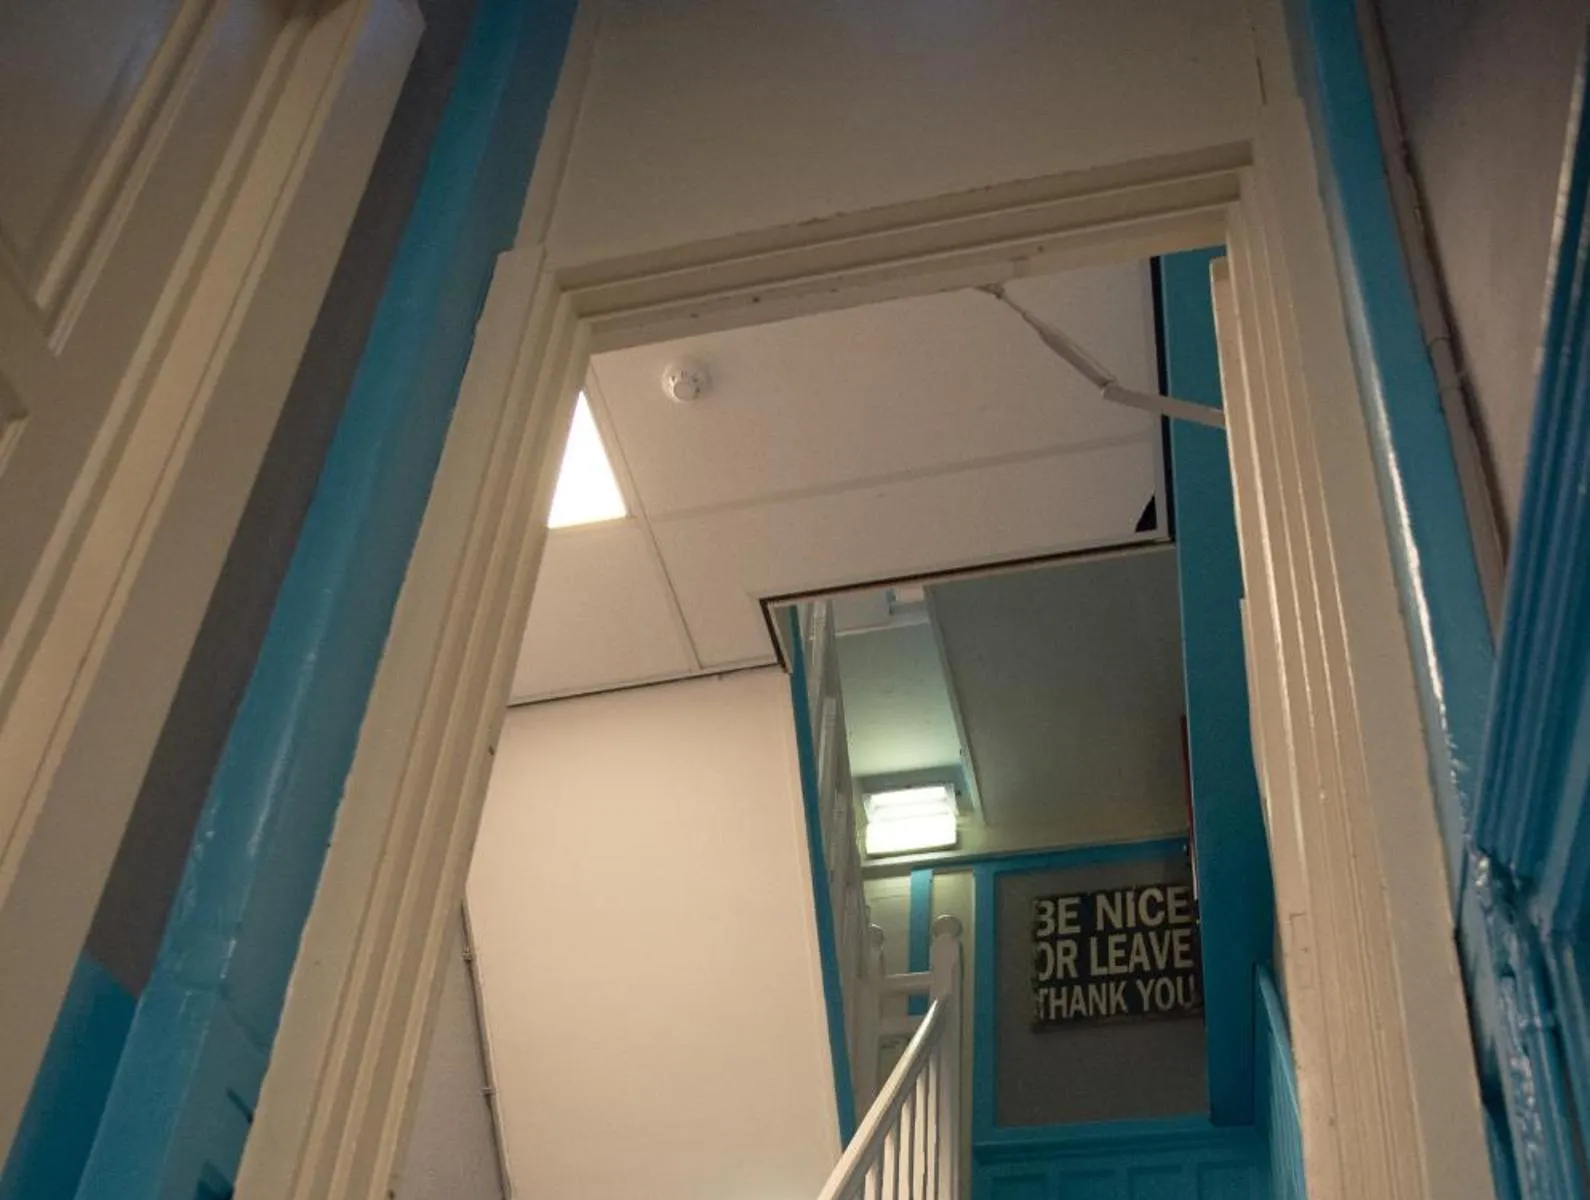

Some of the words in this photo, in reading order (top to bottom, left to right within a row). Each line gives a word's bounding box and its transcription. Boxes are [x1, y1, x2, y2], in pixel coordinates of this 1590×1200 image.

[1034, 898, 1081, 936] BE
[1096, 887, 1192, 930] NICE
[1037, 940, 1078, 980] OR
[1090, 929, 1193, 975] LEAVE
[1038, 981, 1128, 1019] THANK
[1137, 974, 1195, 1010] YOU
